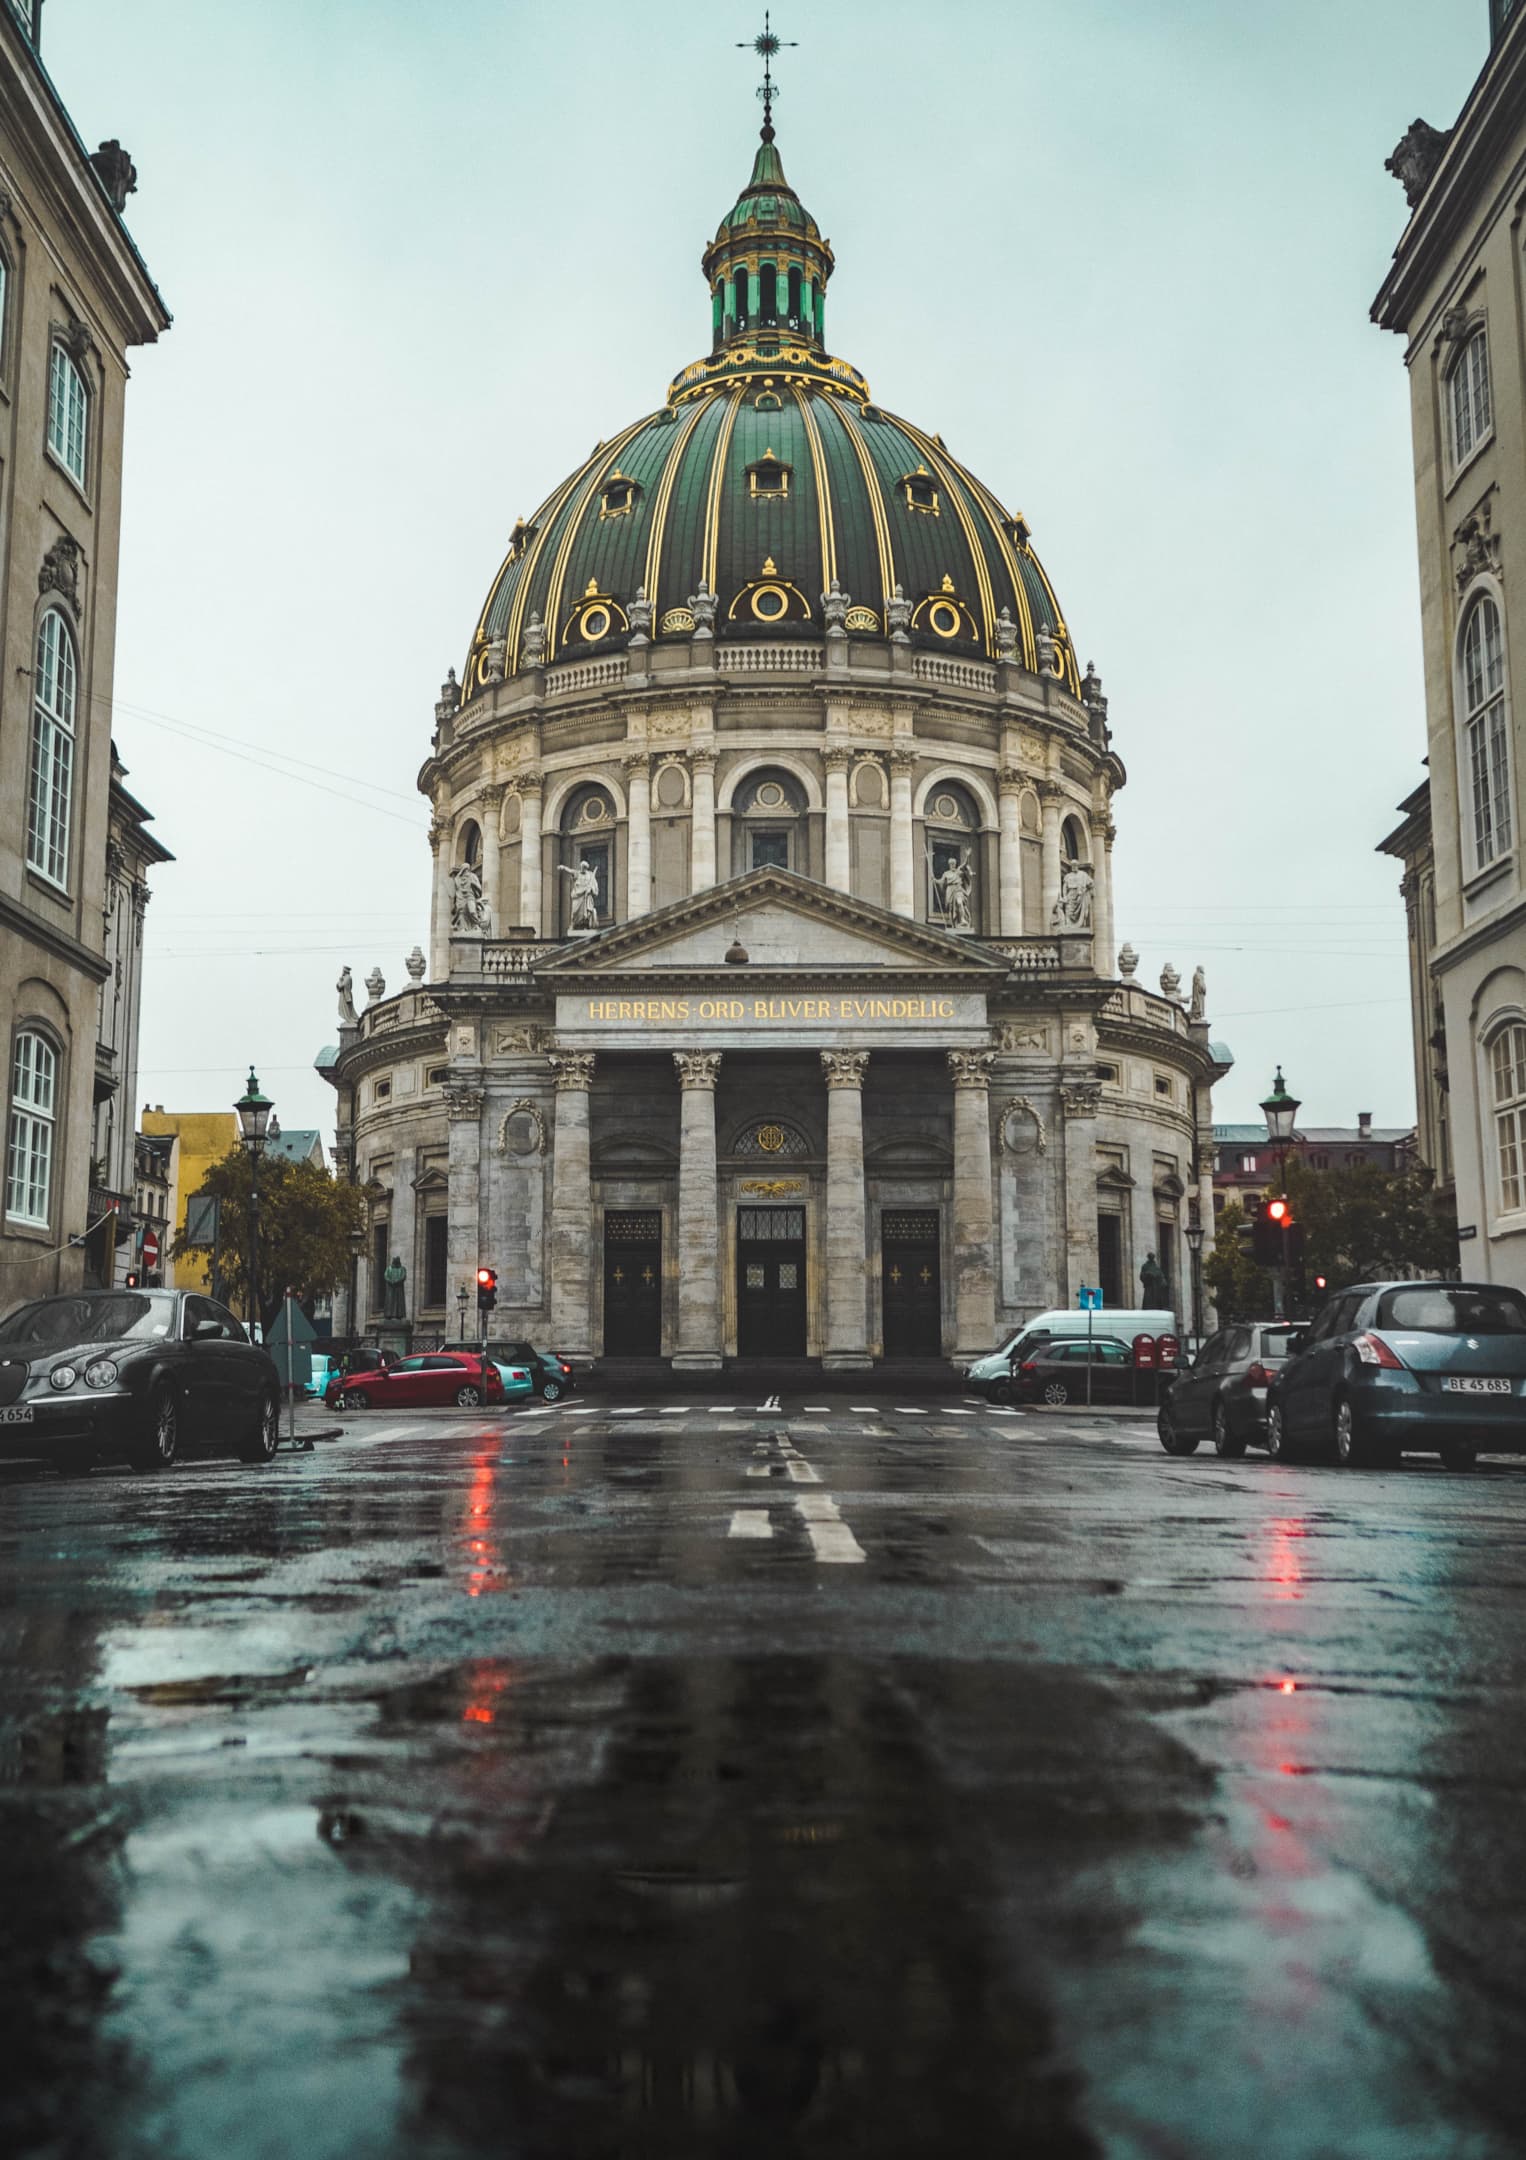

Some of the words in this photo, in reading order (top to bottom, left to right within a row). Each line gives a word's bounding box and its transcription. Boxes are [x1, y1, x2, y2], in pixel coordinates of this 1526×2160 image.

[589, 1001, 689, 1020] HERRENS
[699, 1001, 745, 1020] ORD
[754, 1000, 831, 1018] BLIVER
[840, 1000, 955, 1017] EVINDELIG
[1451, 1379, 1466, 1390] BE
[1470, 1379, 1484, 1391] 45
[1487, 1380, 1510, 1391] 685
[7, 1408, 32, 1421] 654
